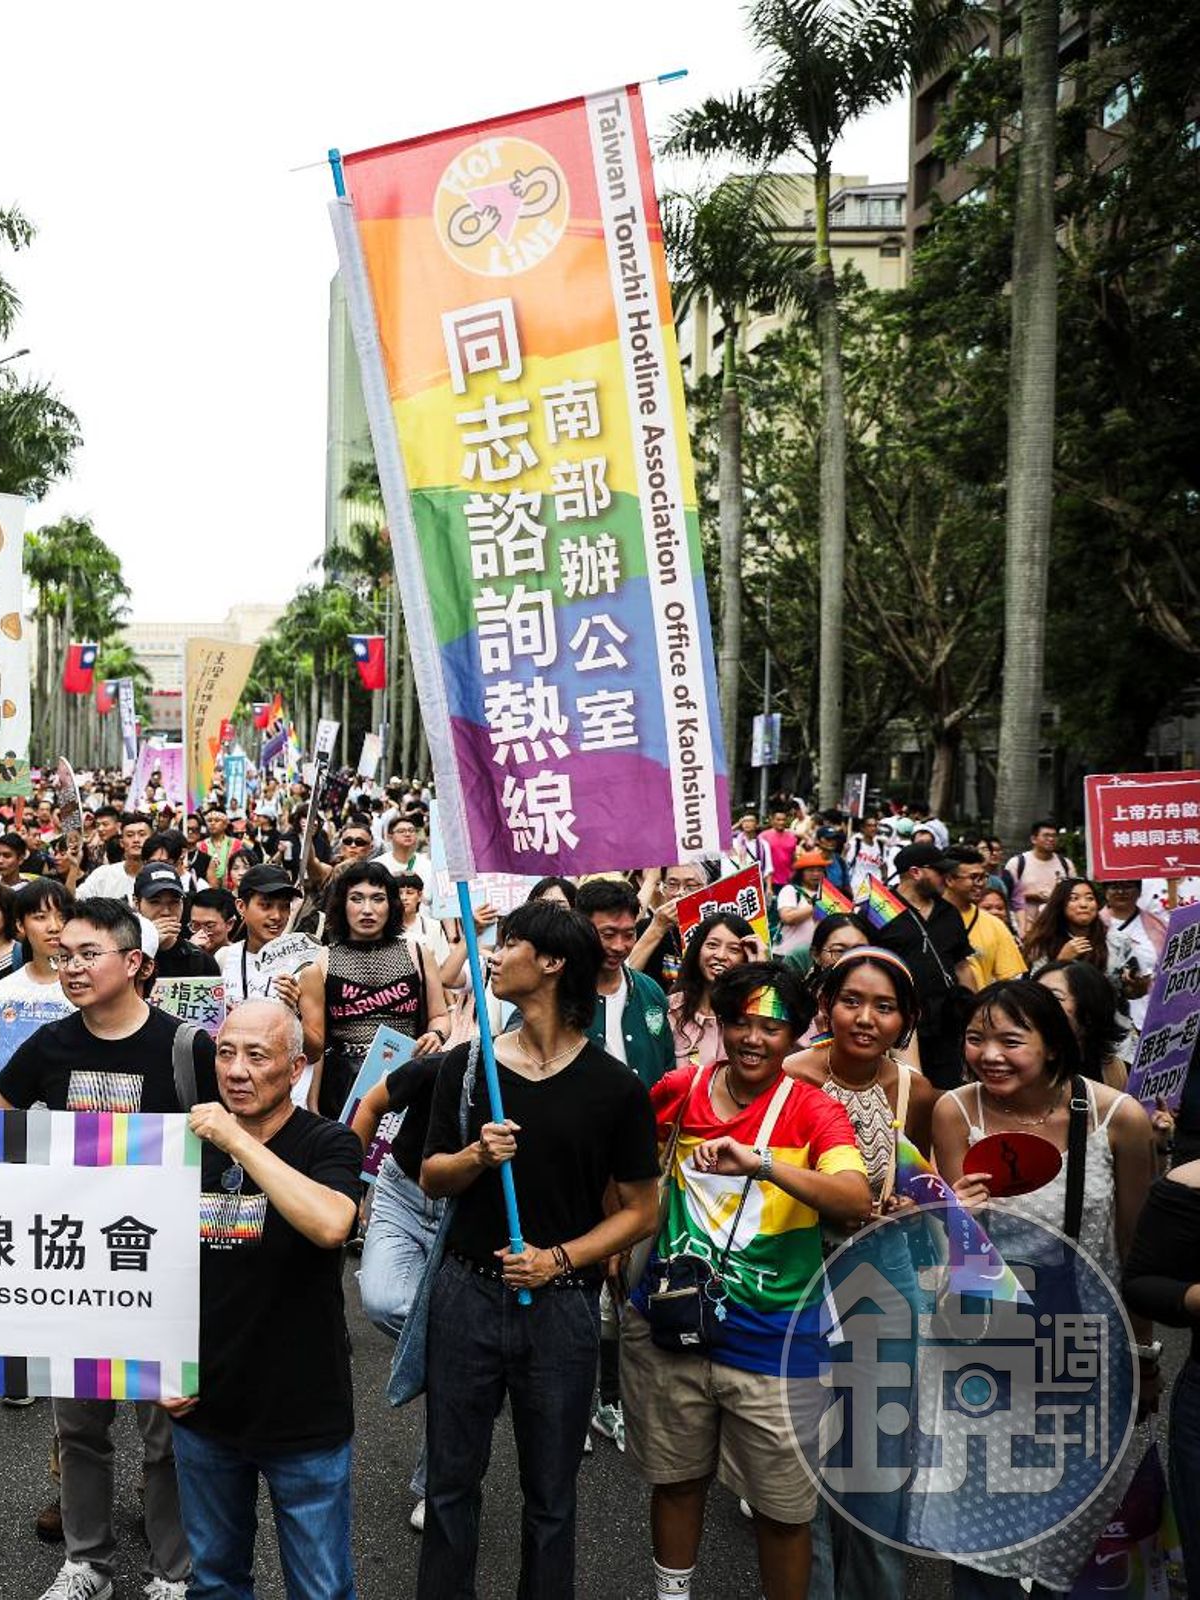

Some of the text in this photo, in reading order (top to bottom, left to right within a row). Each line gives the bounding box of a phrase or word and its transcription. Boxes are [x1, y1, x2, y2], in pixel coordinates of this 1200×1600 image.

[441, 297, 580, 855] 同志諮詢熱線
[540, 379, 638, 751] 南部辦公室
[598, 98, 707, 851] Taiwan Tonzhi Hotline Association Office of Kaohsiung
[1140, 1065, 1188, 1100] happy
